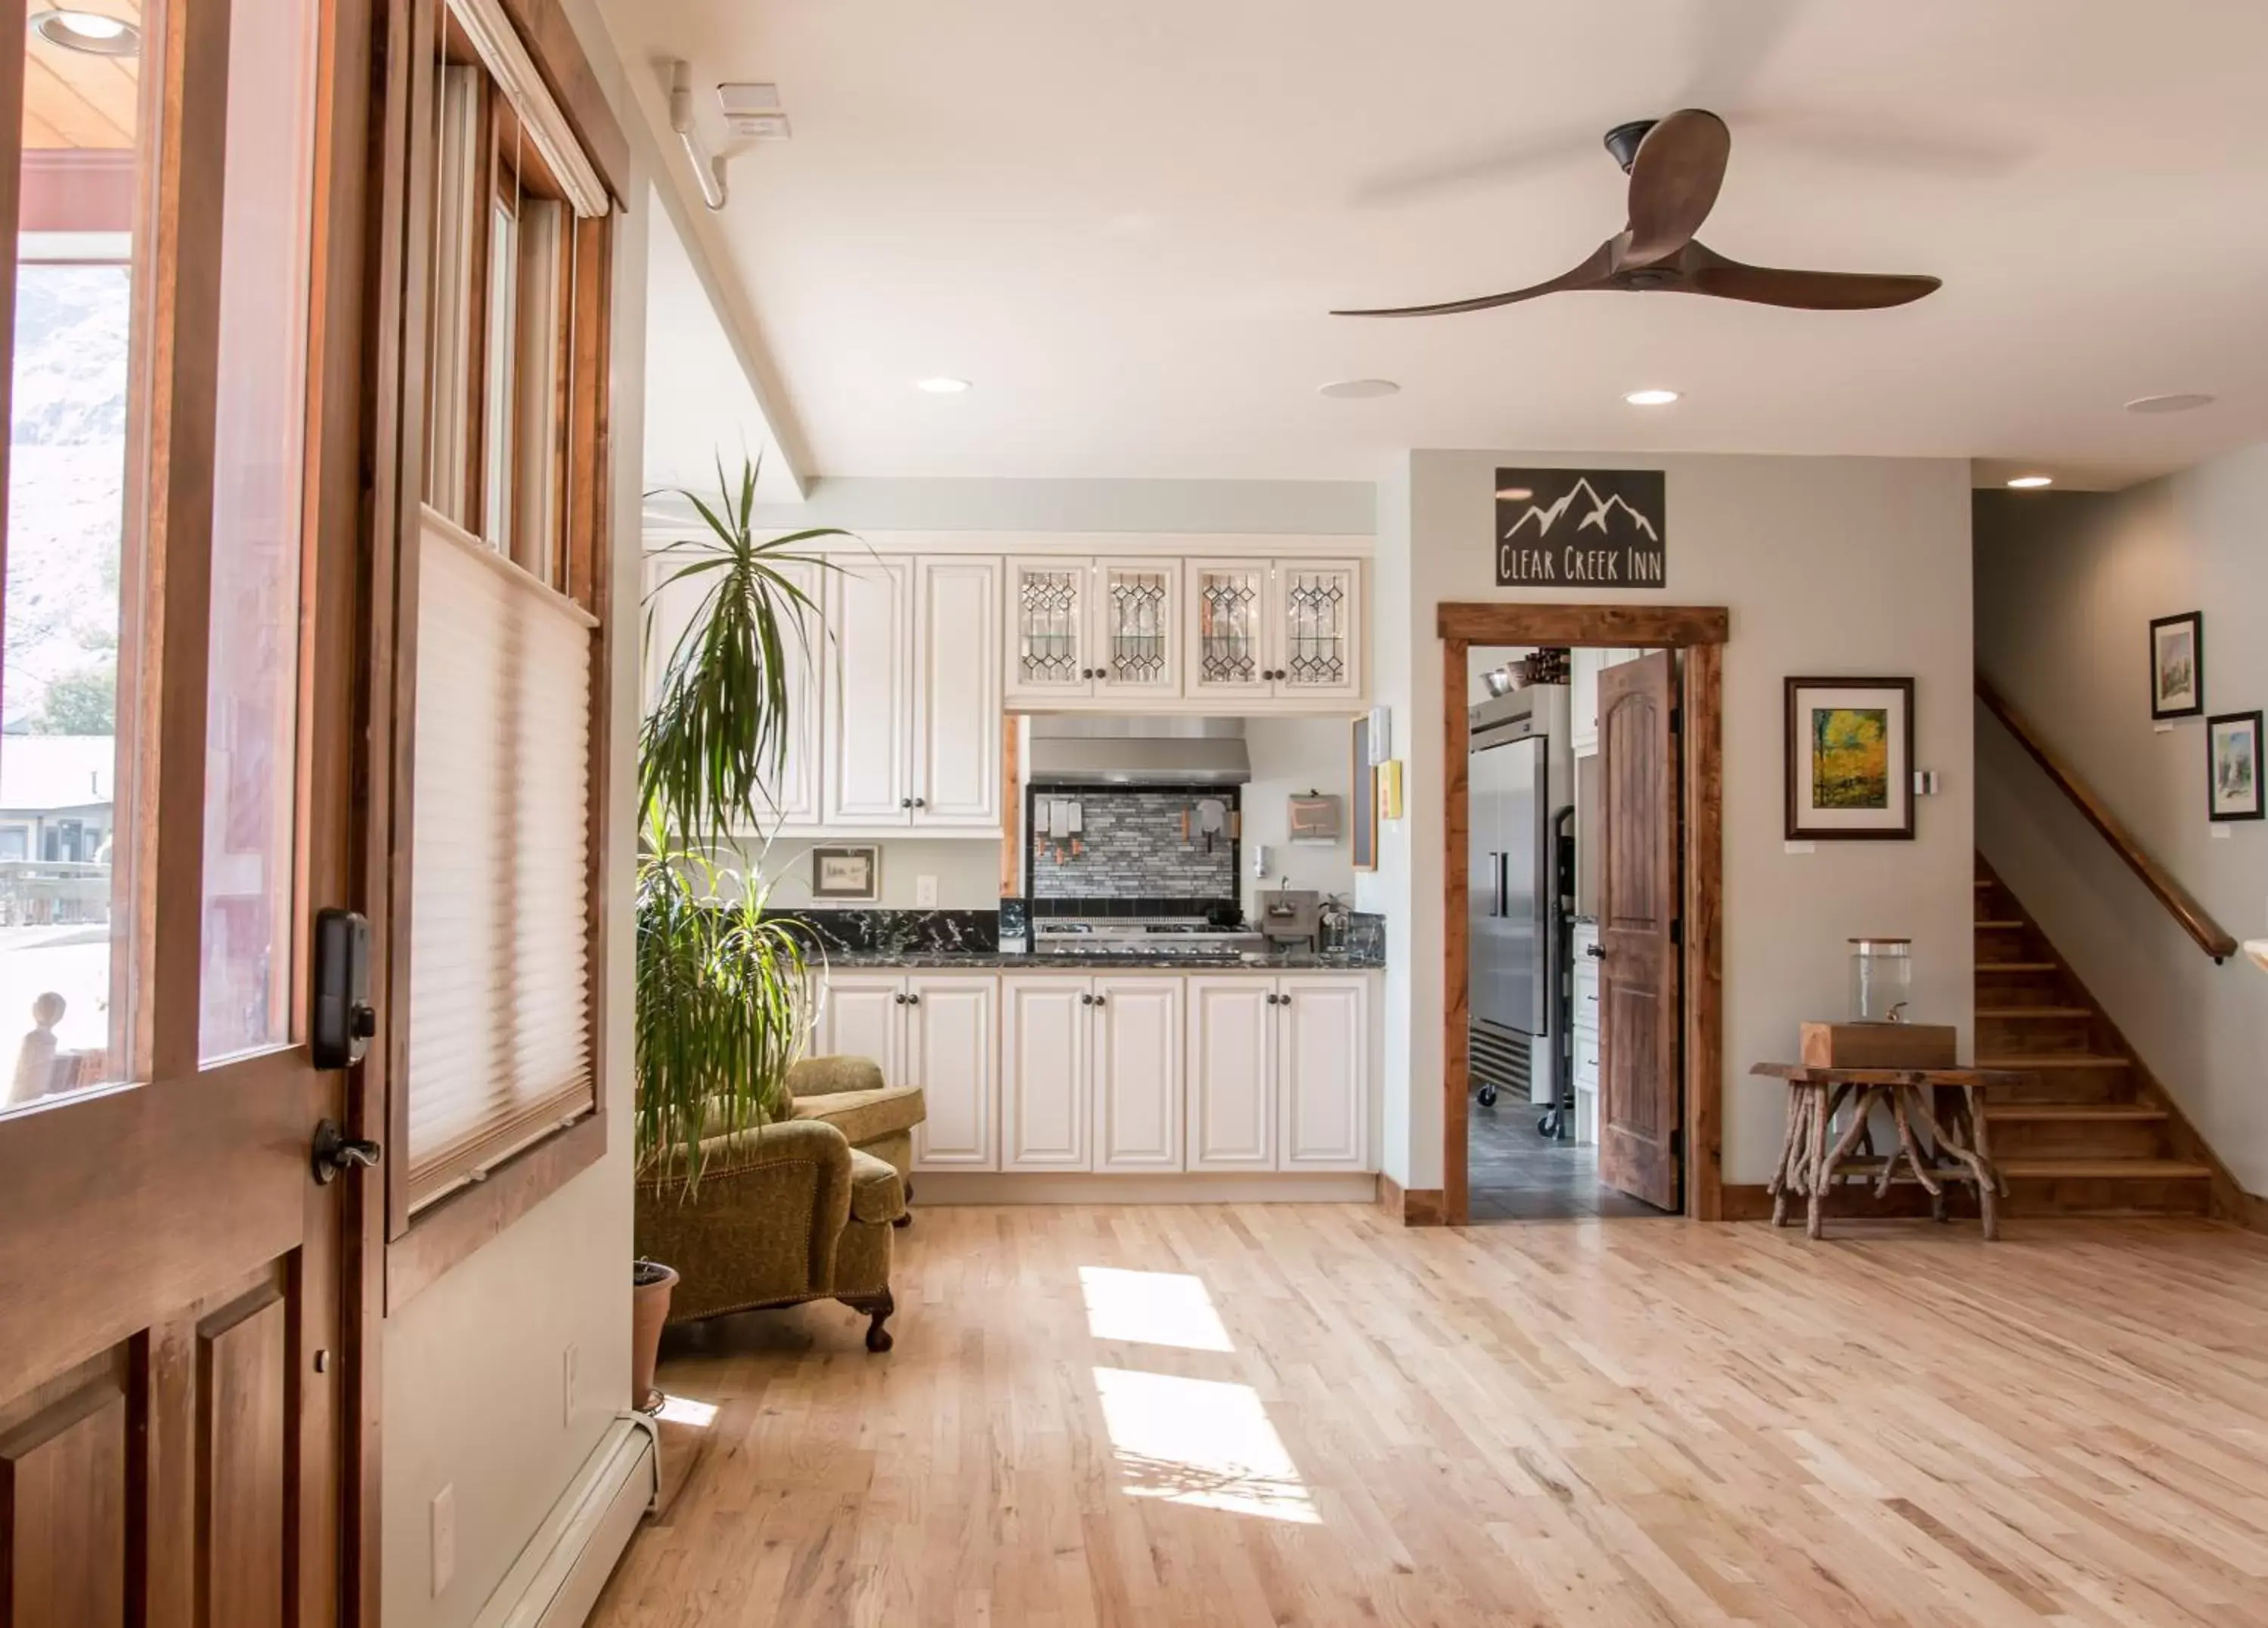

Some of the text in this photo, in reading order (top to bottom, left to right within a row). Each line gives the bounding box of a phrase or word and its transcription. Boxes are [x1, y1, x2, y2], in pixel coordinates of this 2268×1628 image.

[1501, 544, 1662, 581] CLEAR CREEK INN
